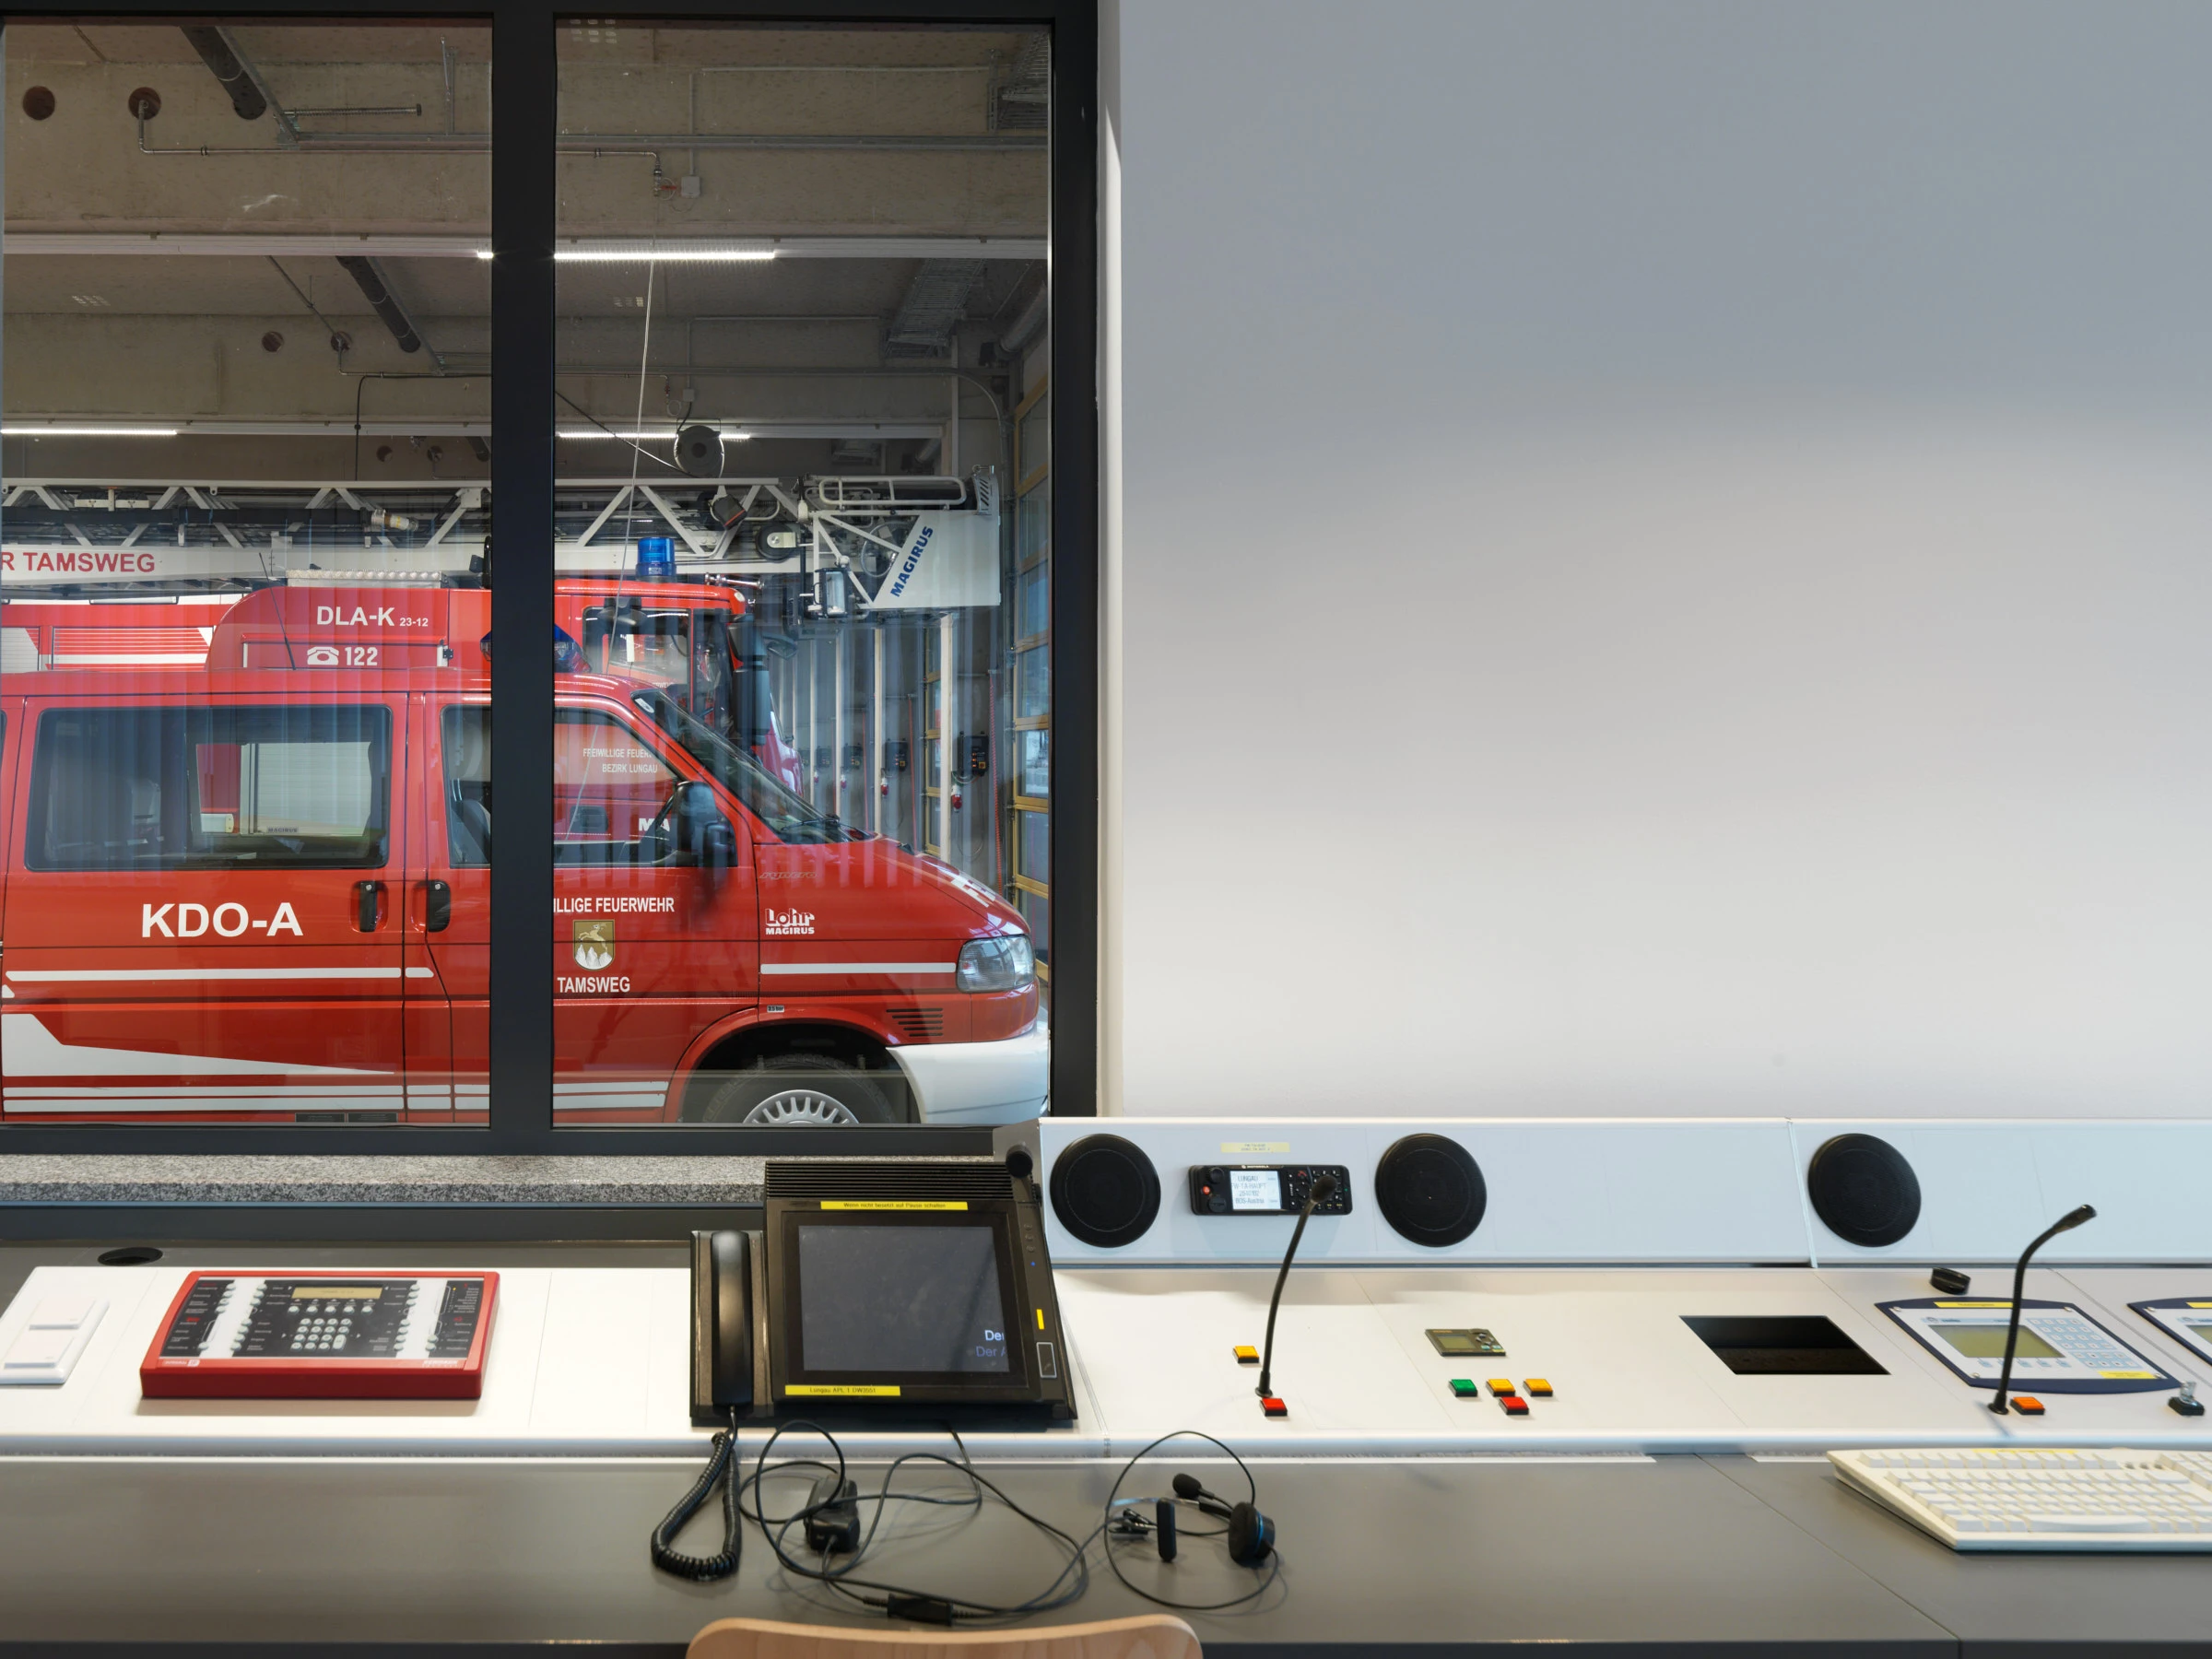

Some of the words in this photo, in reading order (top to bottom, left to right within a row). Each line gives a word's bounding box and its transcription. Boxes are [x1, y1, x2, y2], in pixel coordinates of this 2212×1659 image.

[23, 552, 155, 572] TAMSWEG
[890, 526, 934, 597] MAGIRUS
[317, 606, 394, 626] DLA-K
[399, 618, 429, 627] 23-12
[345, 647, 378, 666] 122
[582, 748, 625, 758] FREIWILLIGE
[602, 763, 628, 772] BEZIRK
[629, 764, 658, 773] LUNGAU
[595, 897, 676, 912] FEUERWEHR
[142, 901, 304, 938] KDO-A
[765, 908, 816, 927] Lohr
[765, 926, 815, 935] MAGIRUS
[557, 976, 631, 994] TAMSWEG
[975, 1346, 997, 1357] Der
